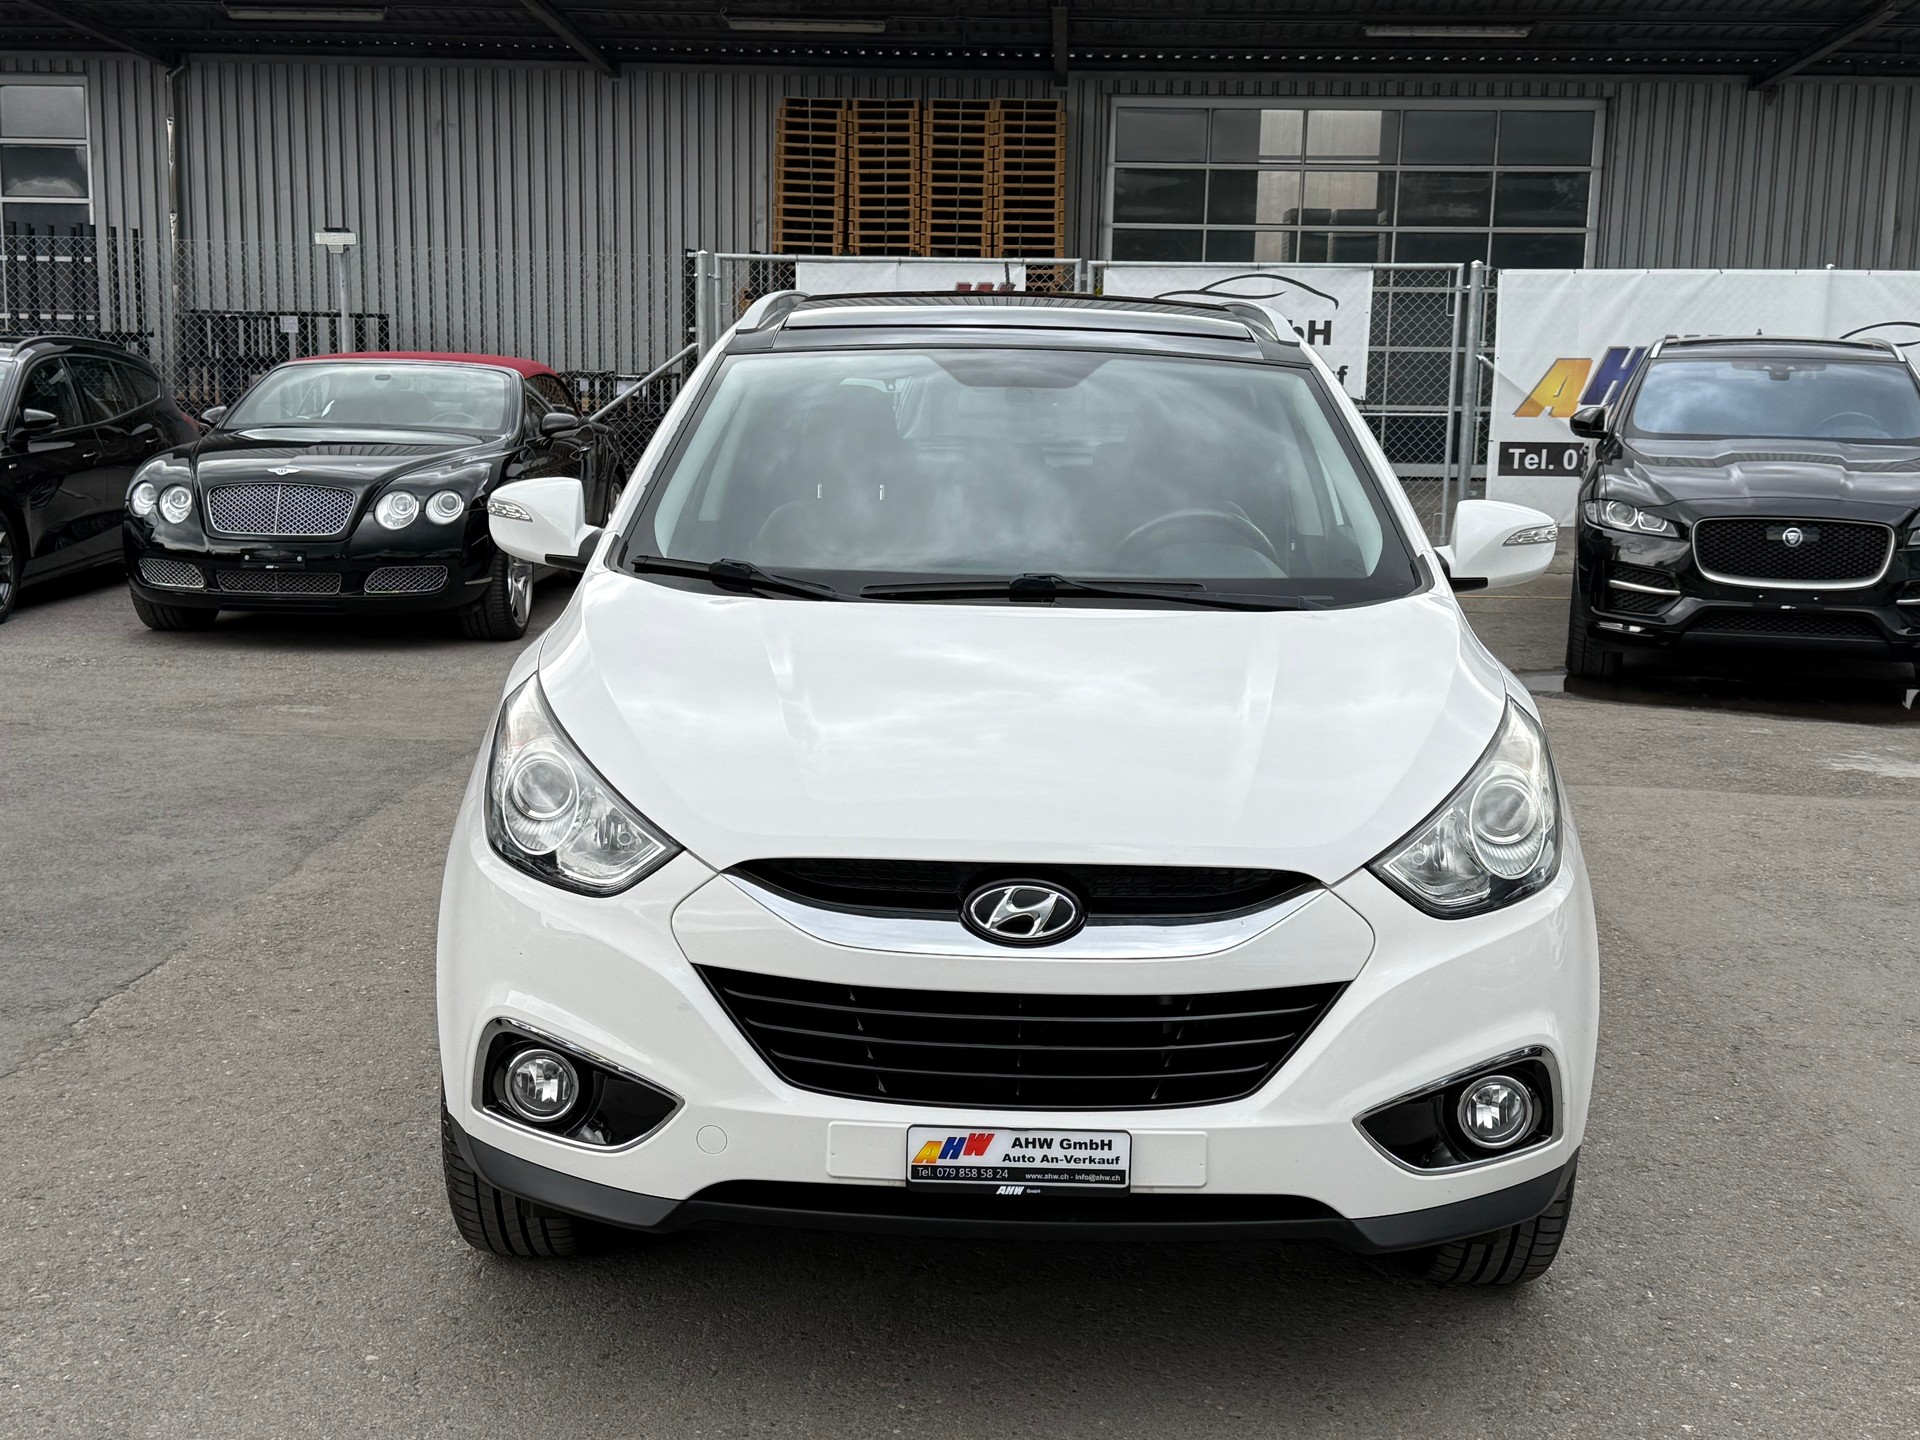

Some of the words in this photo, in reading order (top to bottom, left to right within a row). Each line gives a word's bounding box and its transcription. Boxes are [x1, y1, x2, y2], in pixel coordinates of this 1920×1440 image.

[1508, 448, 1554, 470] Tel.
[911, 1133, 995, 1164] AHW
[1011, 1137, 1054, 1150] AHW
[1060, 1138, 1113, 1151] GmbH
[1002, 1153, 1036, 1163] Auto
[1040, 1154, 1121, 1165] An-Verkauf
[917, 1167, 934, 1177] Tel.
[937, 1168, 956, 1178] 079
[959, 1168, 978, 1178] 858
[981, 1169, 993, 1179] 58
[996, 1169, 1009, 1179] 24
[1075, 1174, 1121, 1182] info@ahw.ch
[996, 1186, 1025, 1195] AHW
